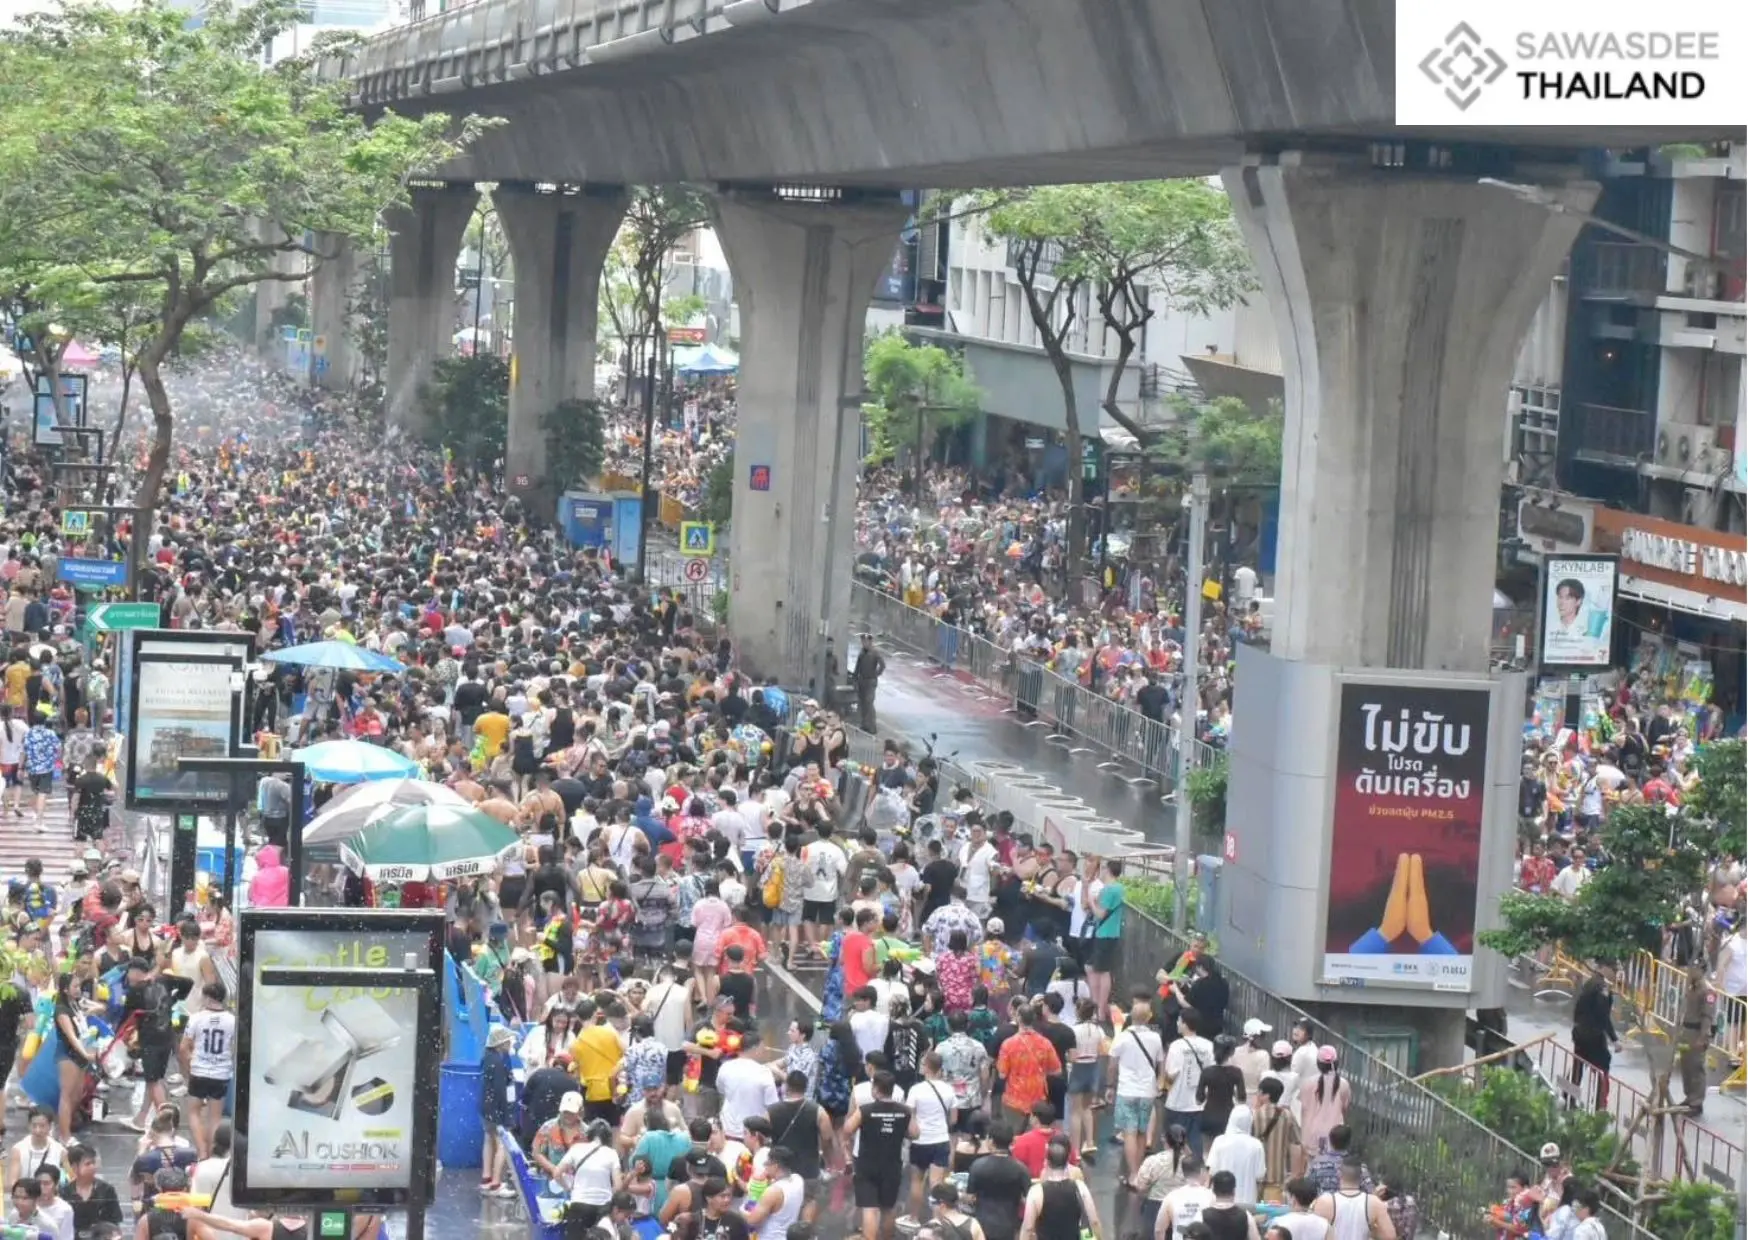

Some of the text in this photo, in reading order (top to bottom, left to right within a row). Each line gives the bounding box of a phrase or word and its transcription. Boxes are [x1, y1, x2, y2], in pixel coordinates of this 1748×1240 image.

[1360, 703, 1471, 756] ไม่ขับ
[1388, 753, 1424, 772] โปรด
[1355, 765, 1471, 800] ดับเครื่อง
[1421, 809, 1455, 820] PM2.5
[203, 1029, 225, 1055] 10
[316, 1141, 400, 1161] CUSHION
